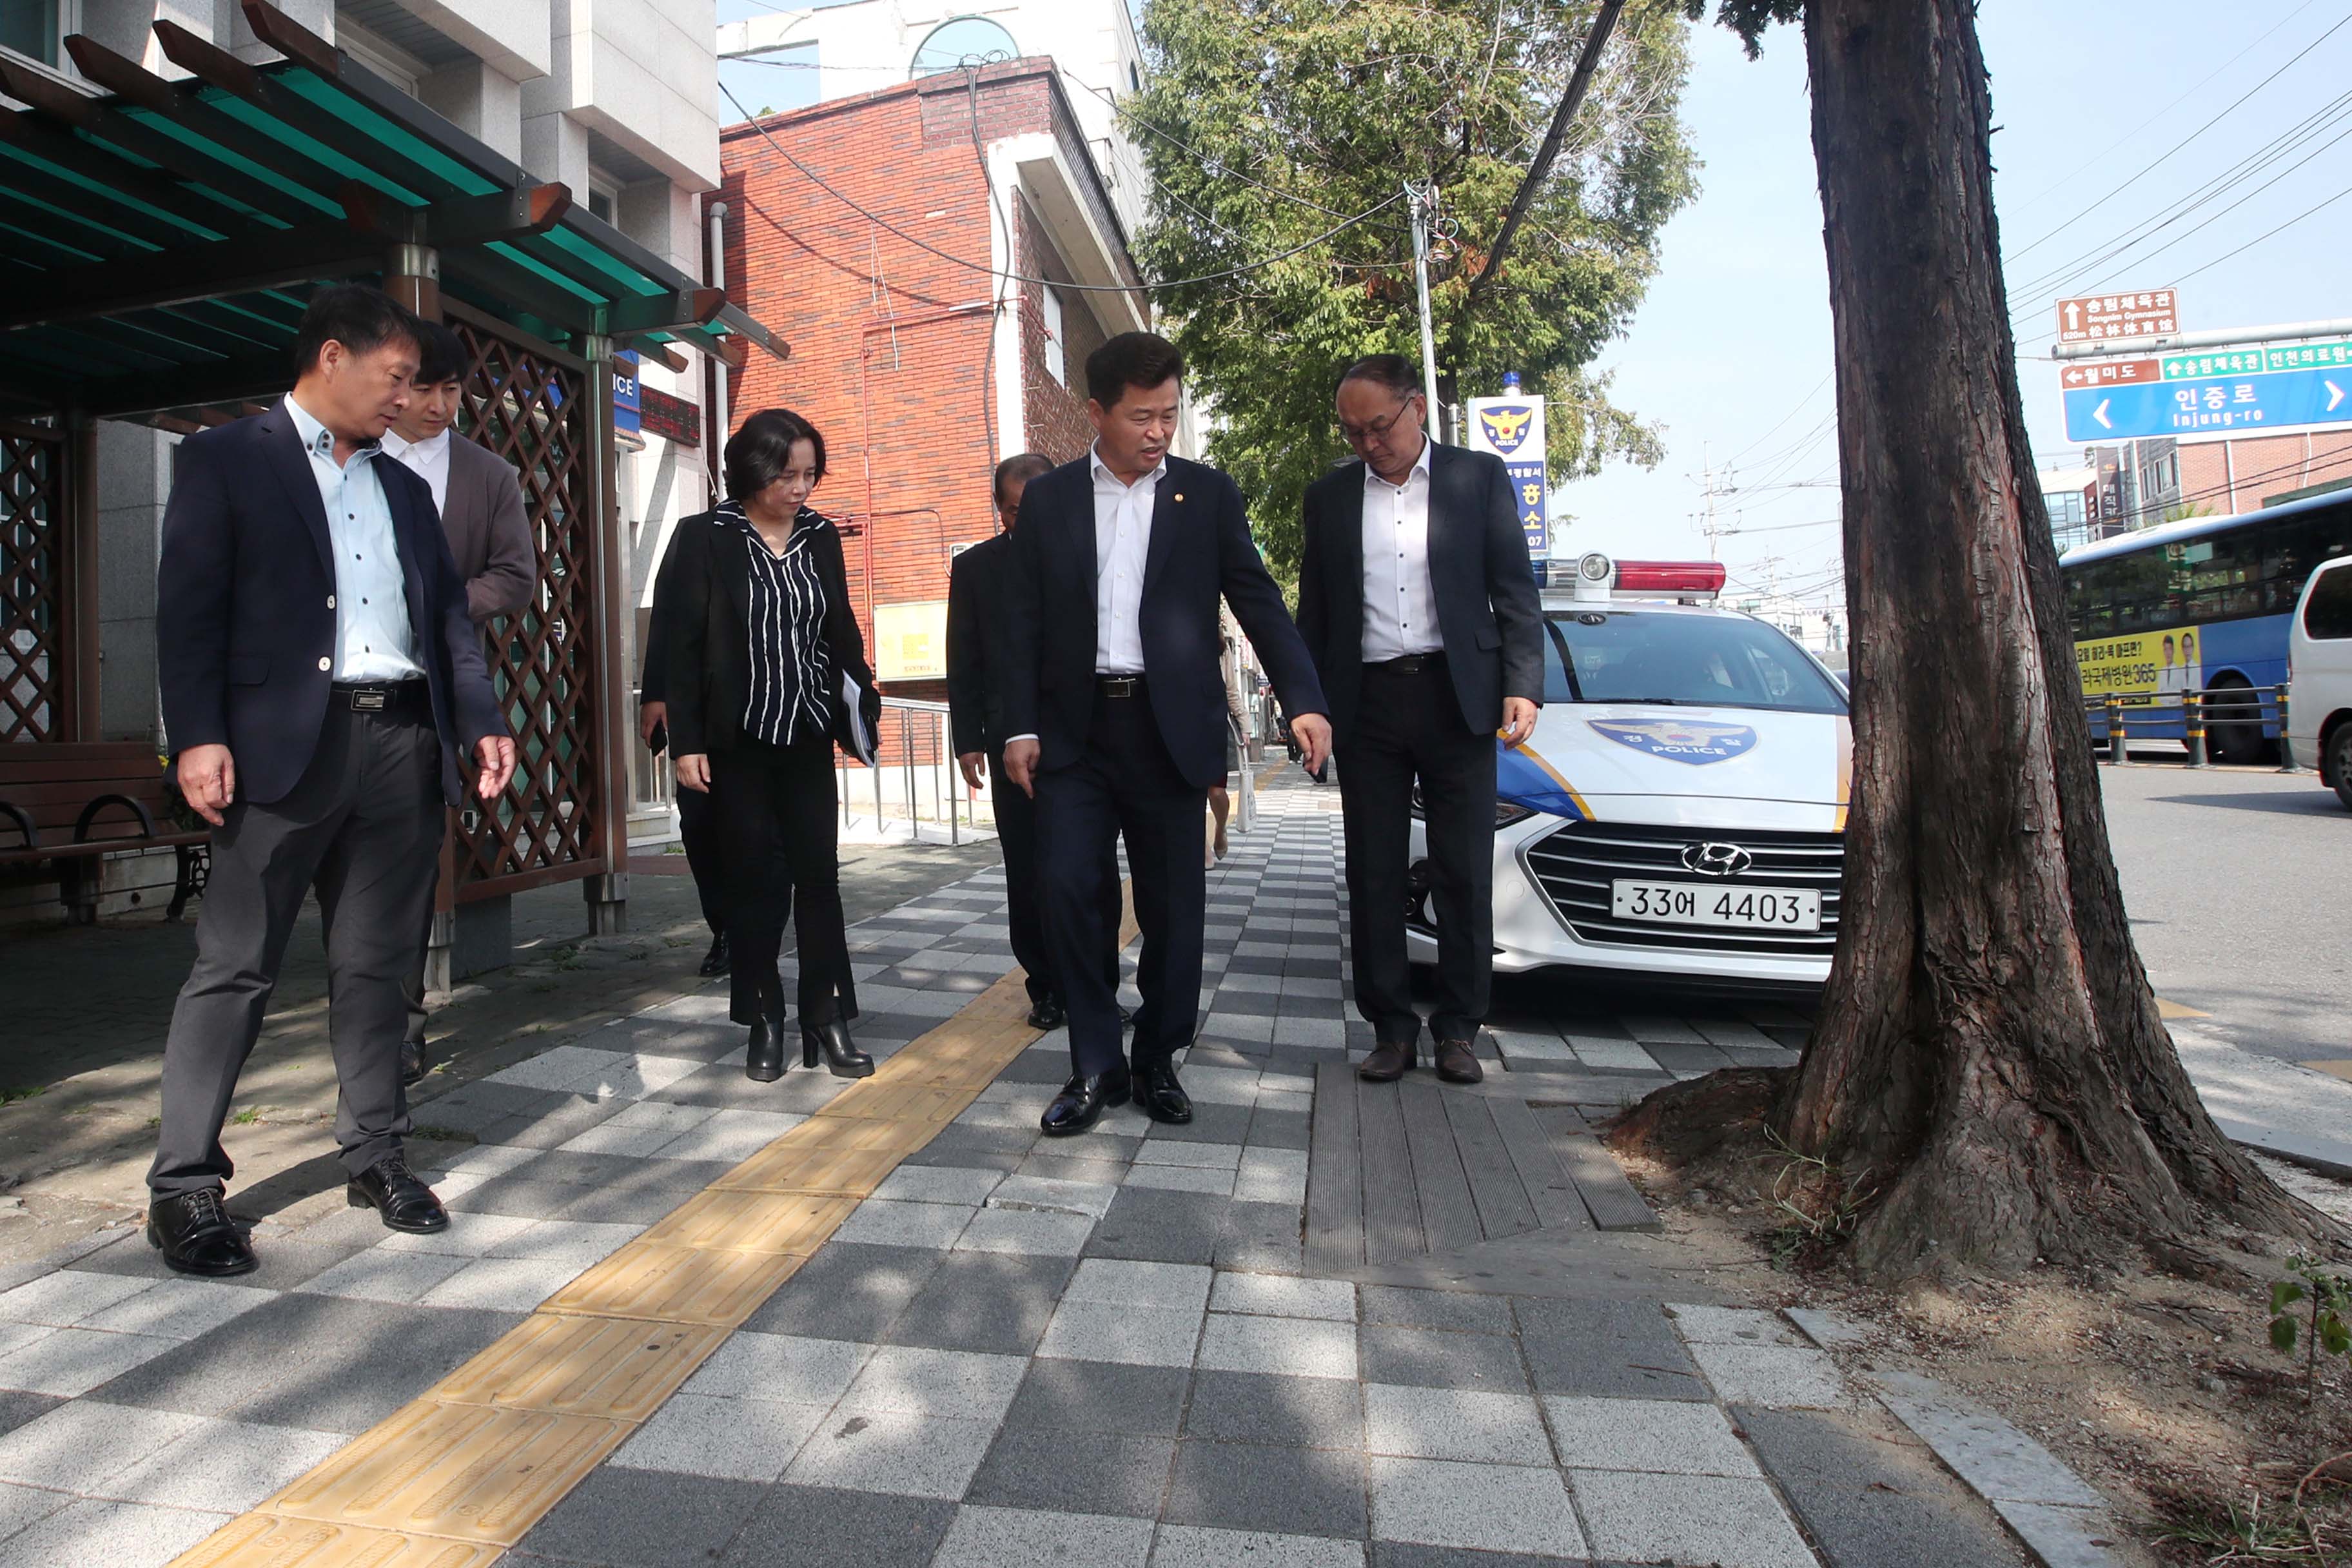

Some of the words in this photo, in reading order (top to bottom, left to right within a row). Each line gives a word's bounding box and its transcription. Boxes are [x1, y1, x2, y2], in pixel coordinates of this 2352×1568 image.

[2086, 292, 2170, 313] 송림체육관
[2087, 313, 2122, 324] Songnim
[2124, 309, 2171, 320] Gymnasium
[2063, 331, 2086, 340] 520m
[2184, 353, 2259, 376] 송림체육관
[2269, 346, 2346, 368] 인천의료원
[2085, 364, 2137, 384] 월미도
[2175, 384, 2257, 411] 인중로
[2173, 409, 2263, 428] Injung-ro
[1651, 745, 1727, 756] POLICE
[1631, 887, 1695, 917] 33어
[1713, 892, 1800, 923] 4403
